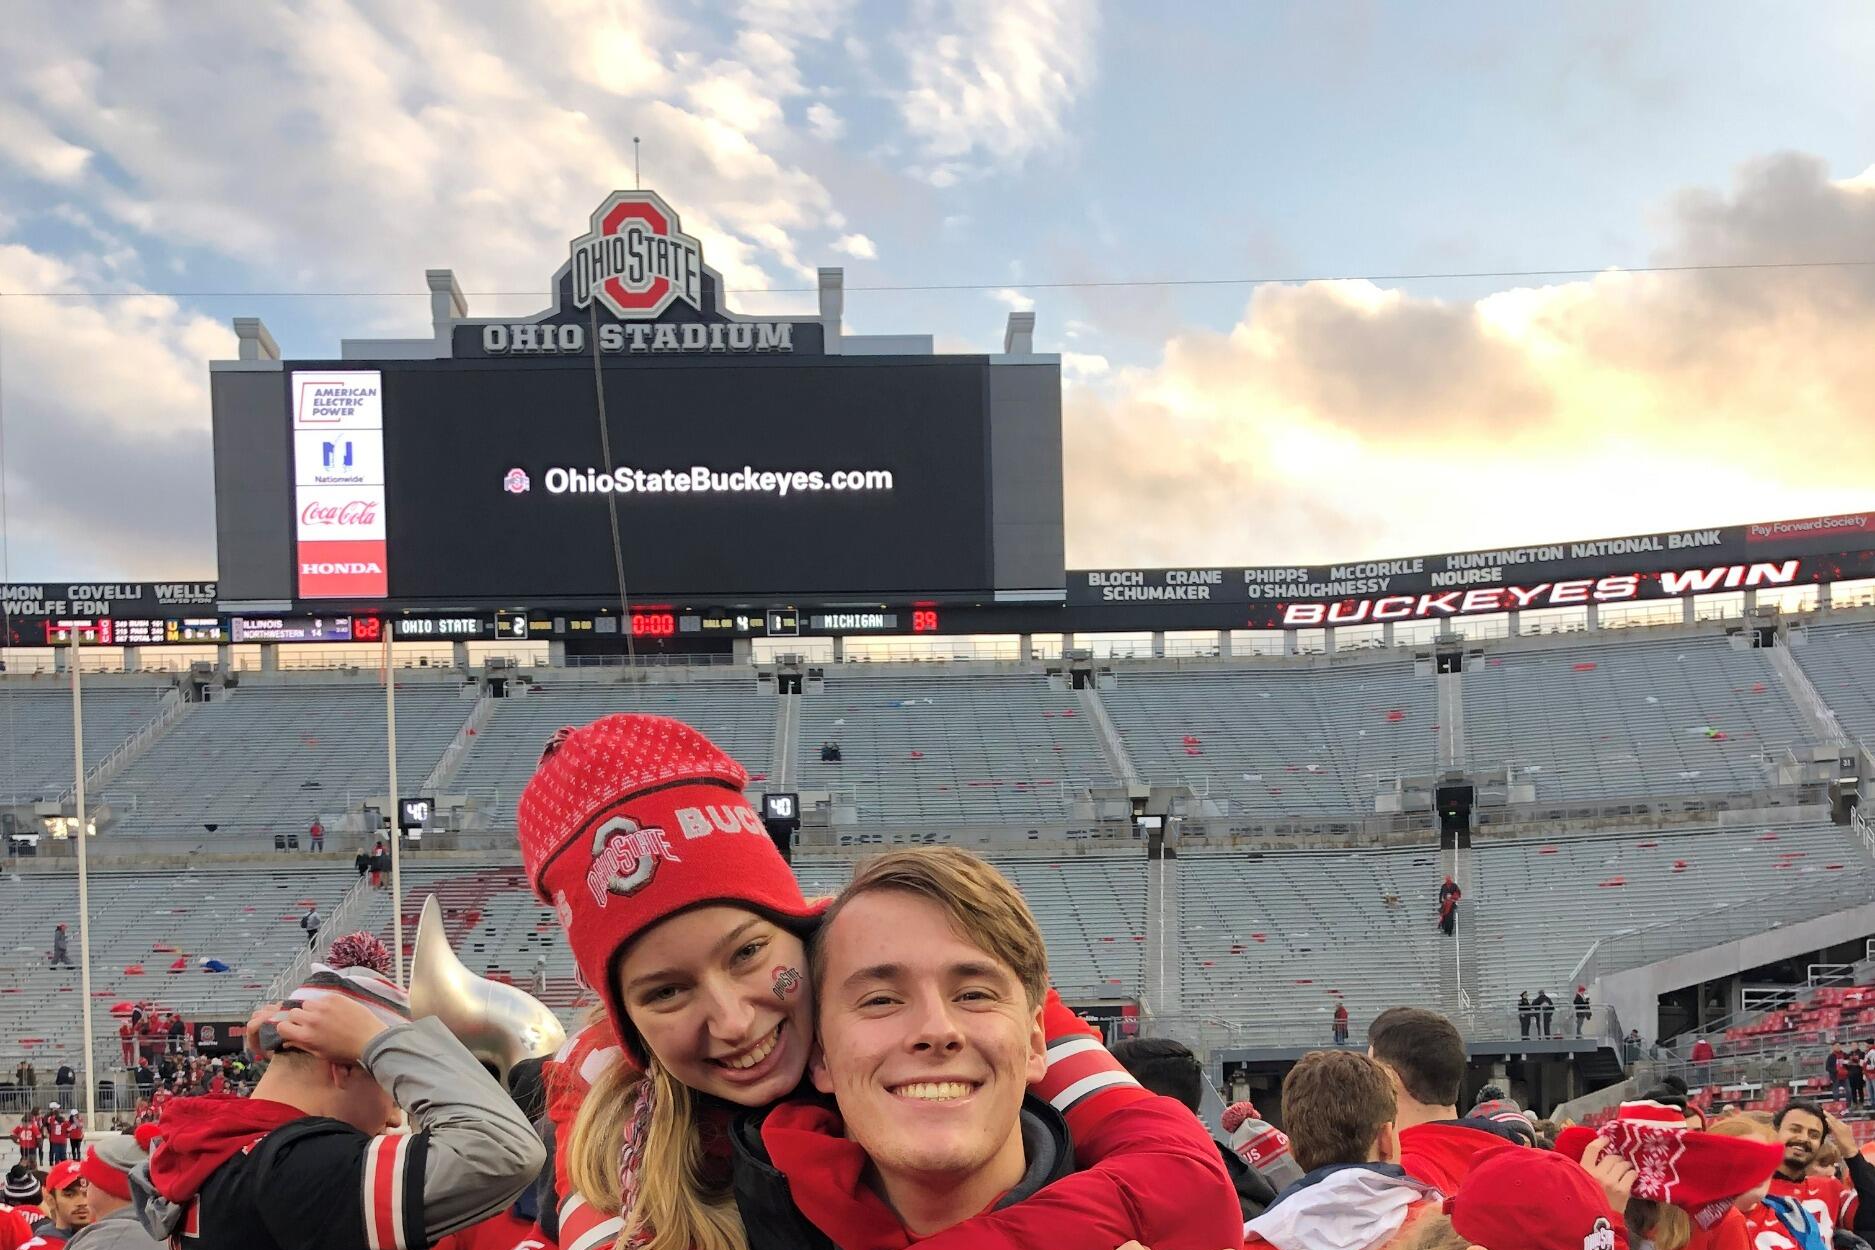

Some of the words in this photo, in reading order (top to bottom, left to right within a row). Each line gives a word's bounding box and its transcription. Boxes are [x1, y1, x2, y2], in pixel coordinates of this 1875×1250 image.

[482, 324, 585, 354] OHIO
[599, 323, 794, 353] STADIUM
[314, 387, 377, 398] AMERICAN
[312, 397, 364, 407] ELECTRIC
[311, 406, 355, 417] POWER
[314, 475, 364, 483] Nationwide
[544, 466, 893, 497] OhioStateBuckeyes.com
[1751, 523, 1773, 537] Pay
[1774, 517, 1822, 533] Forward
[1822, 514, 1868, 530] Society
[1446, 545, 1564, 570] HUNTINGTON
[1570, 535, 1664, 560] NATIONAL
[1667, 530, 1722, 550] BANK
[301, 561, 382, 575] HONDA
[1244, 568, 1309, 584] PHIPPS
[1330, 559, 1424, 580] McCORKLE
[1088, 571, 1144, 587] BLOCH
[1165, 569, 1223, 585] CRANE
[1431, 566, 1503, 587] NOURSE
[0, 585, 44, 600] MON
[67, 585, 142, 600] COVELLI
[154, 584, 216, 599] WELLS
[1102, 585, 1211, 602] SCHUMAKER
[1248, 577, 1391, 599] O'SHAUGHNESSY
[1282, 573, 1640, 627] BUCKEYES
[1659, 559, 1801, 594] WIN
[2, 600, 67, 615] WOLFE
[72, 600, 110, 615] FDN
[243, 620, 284, 629] ILLINOIS
[402, 619, 432, 633] OHIO
[438, 619, 477, 633] STATE
[513, 616, 525, 635] 2
[632, 614, 674, 637] 0:00
[736, 615, 749, 631] 4
[824, 614, 883, 629] MICHIGAN
[243, 629, 305, 639] NORTHWESTERN
[311, 628, 322, 637] 14
[406, 802, 428, 821] 40
[770, 797, 792, 816] 40
